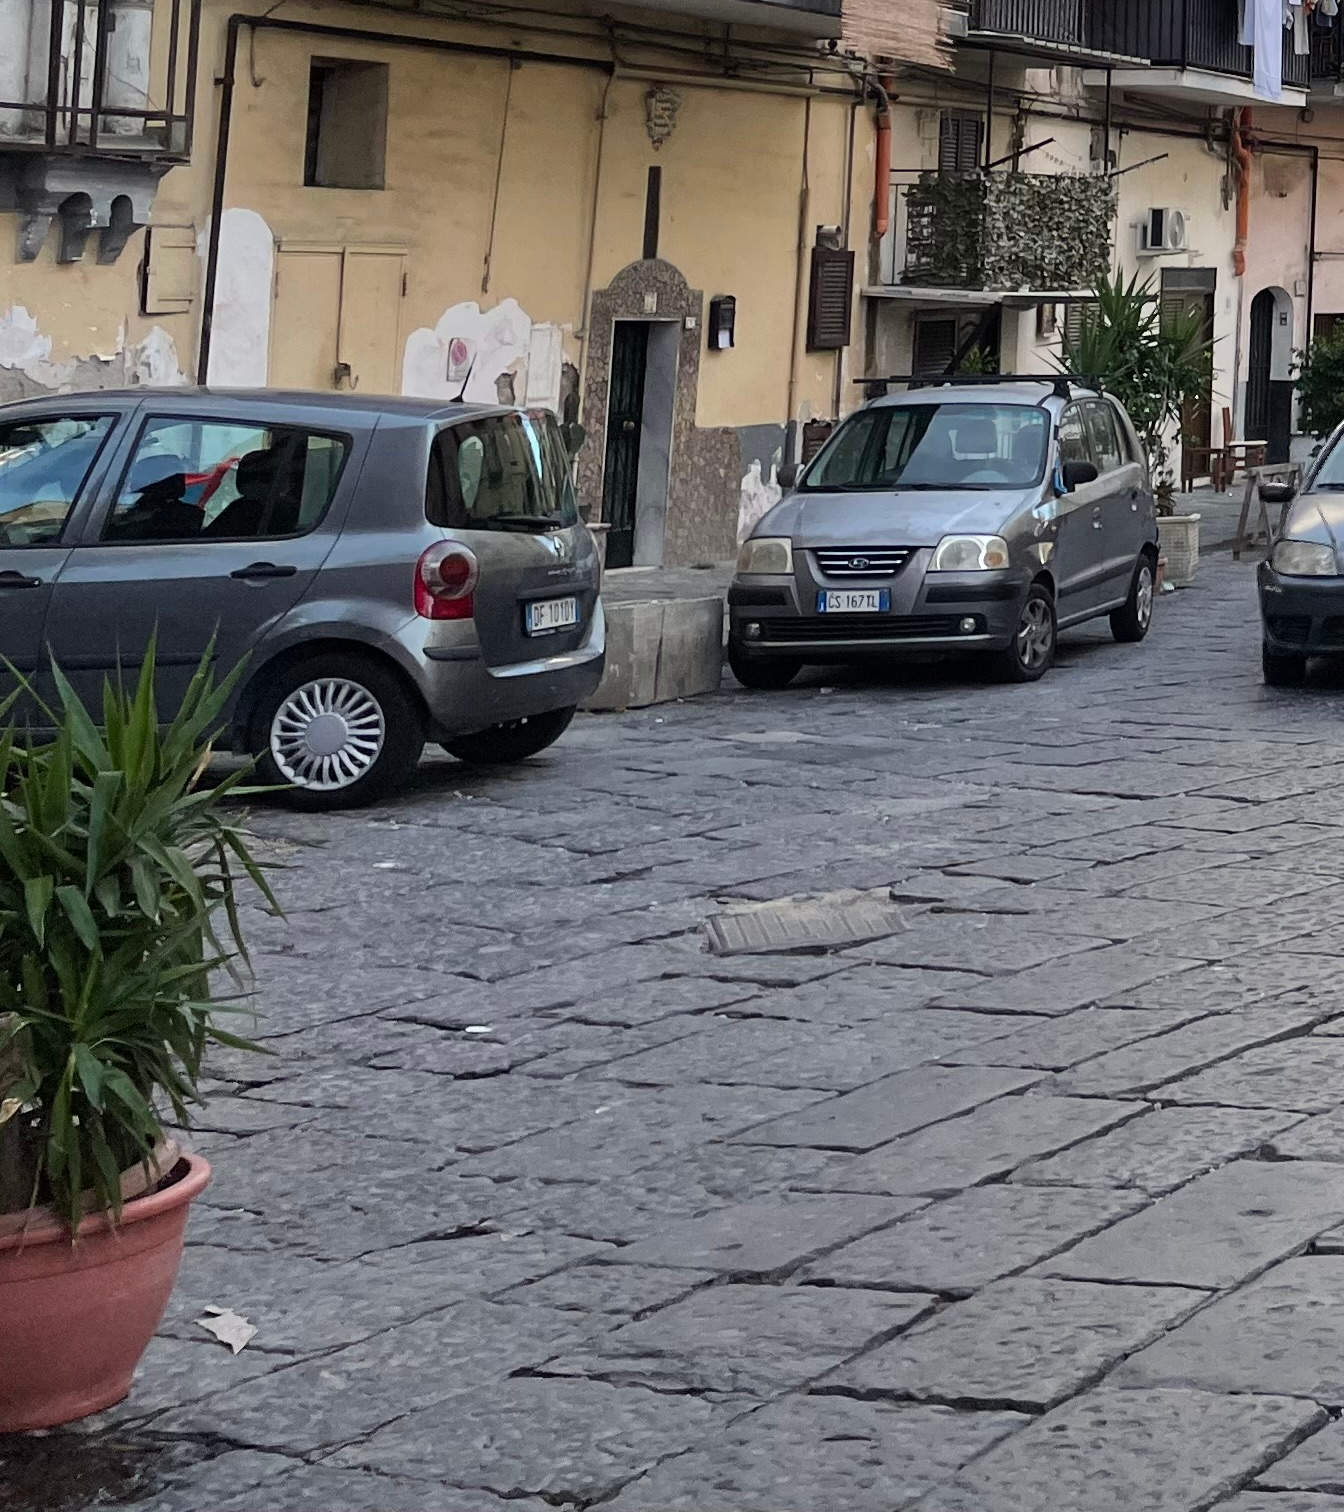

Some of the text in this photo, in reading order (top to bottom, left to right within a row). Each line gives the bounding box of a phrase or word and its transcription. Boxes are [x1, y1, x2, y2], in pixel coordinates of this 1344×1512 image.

[828, 594, 878, 609] CS 167TL
[533, 605, 545, 627] DF
